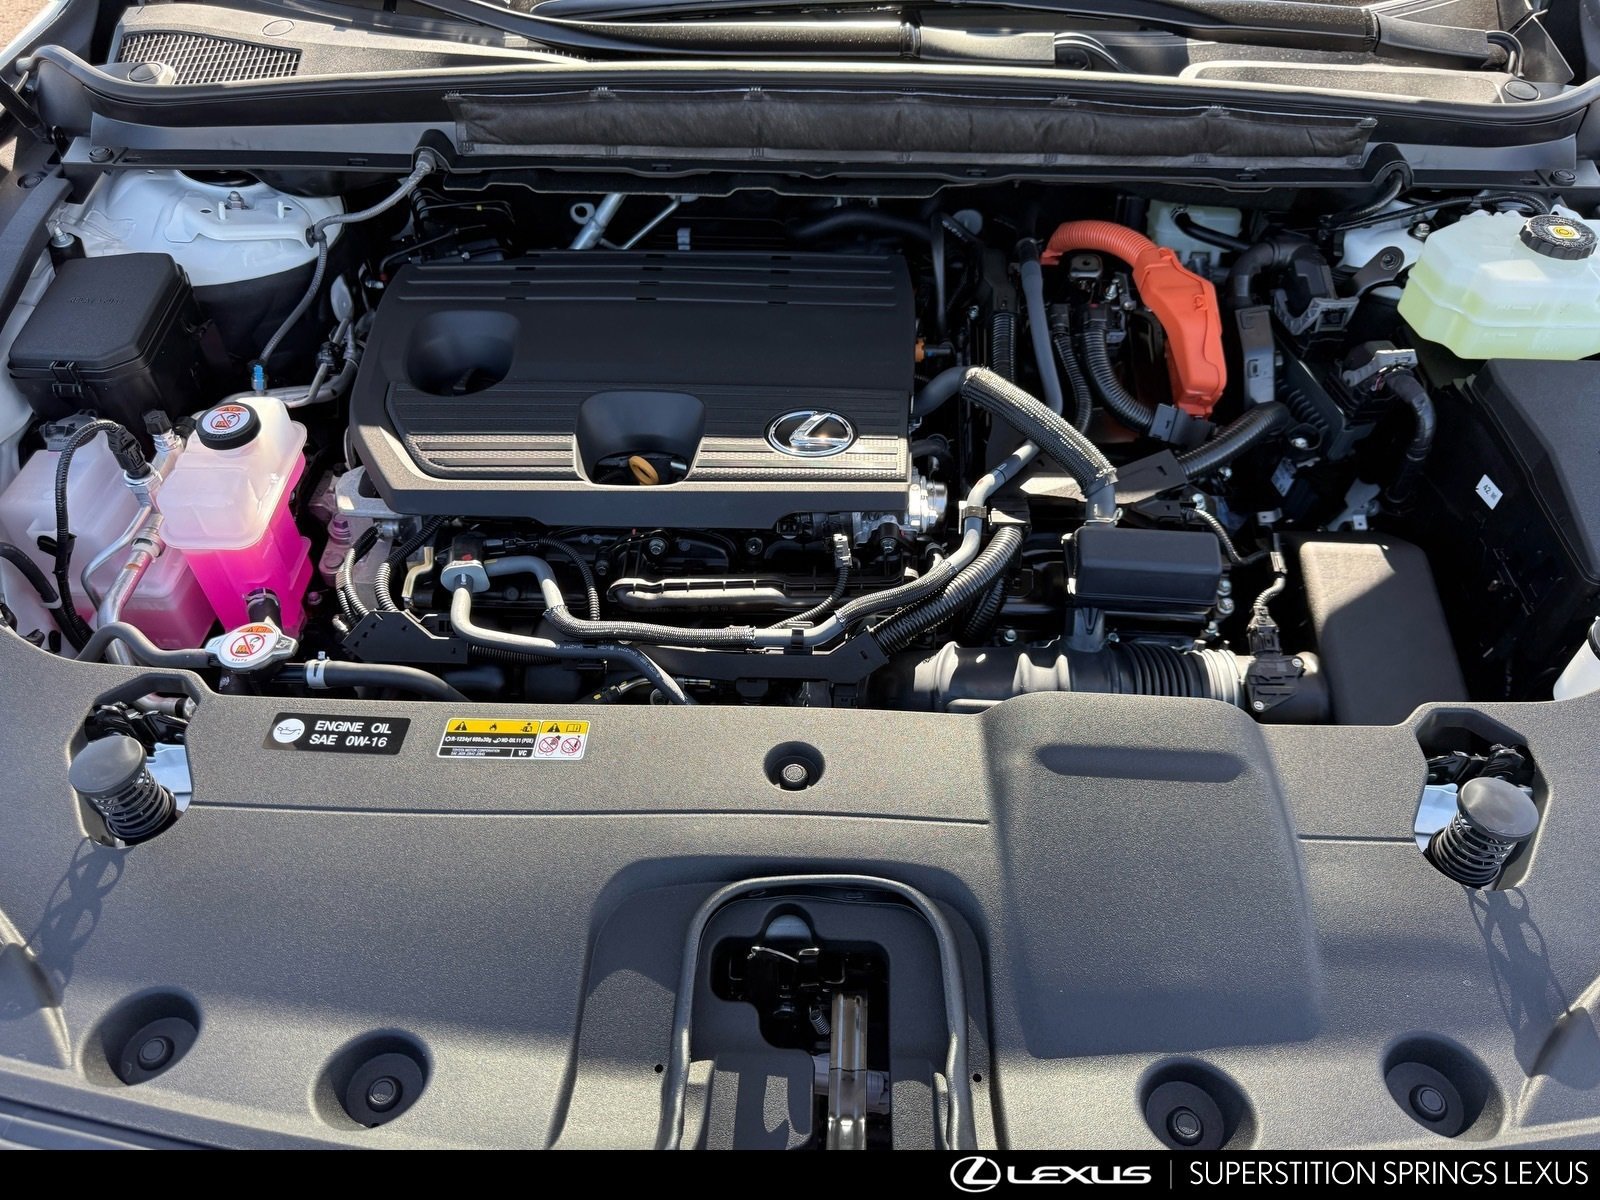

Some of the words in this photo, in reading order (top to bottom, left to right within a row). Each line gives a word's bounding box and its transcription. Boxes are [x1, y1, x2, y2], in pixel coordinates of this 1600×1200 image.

[314, 720, 364, 733] ENGINE
[370, 722, 392, 734] OIL
[309, 734, 338, 746] SAE
[345, 736, 387, 748] 0W-16
